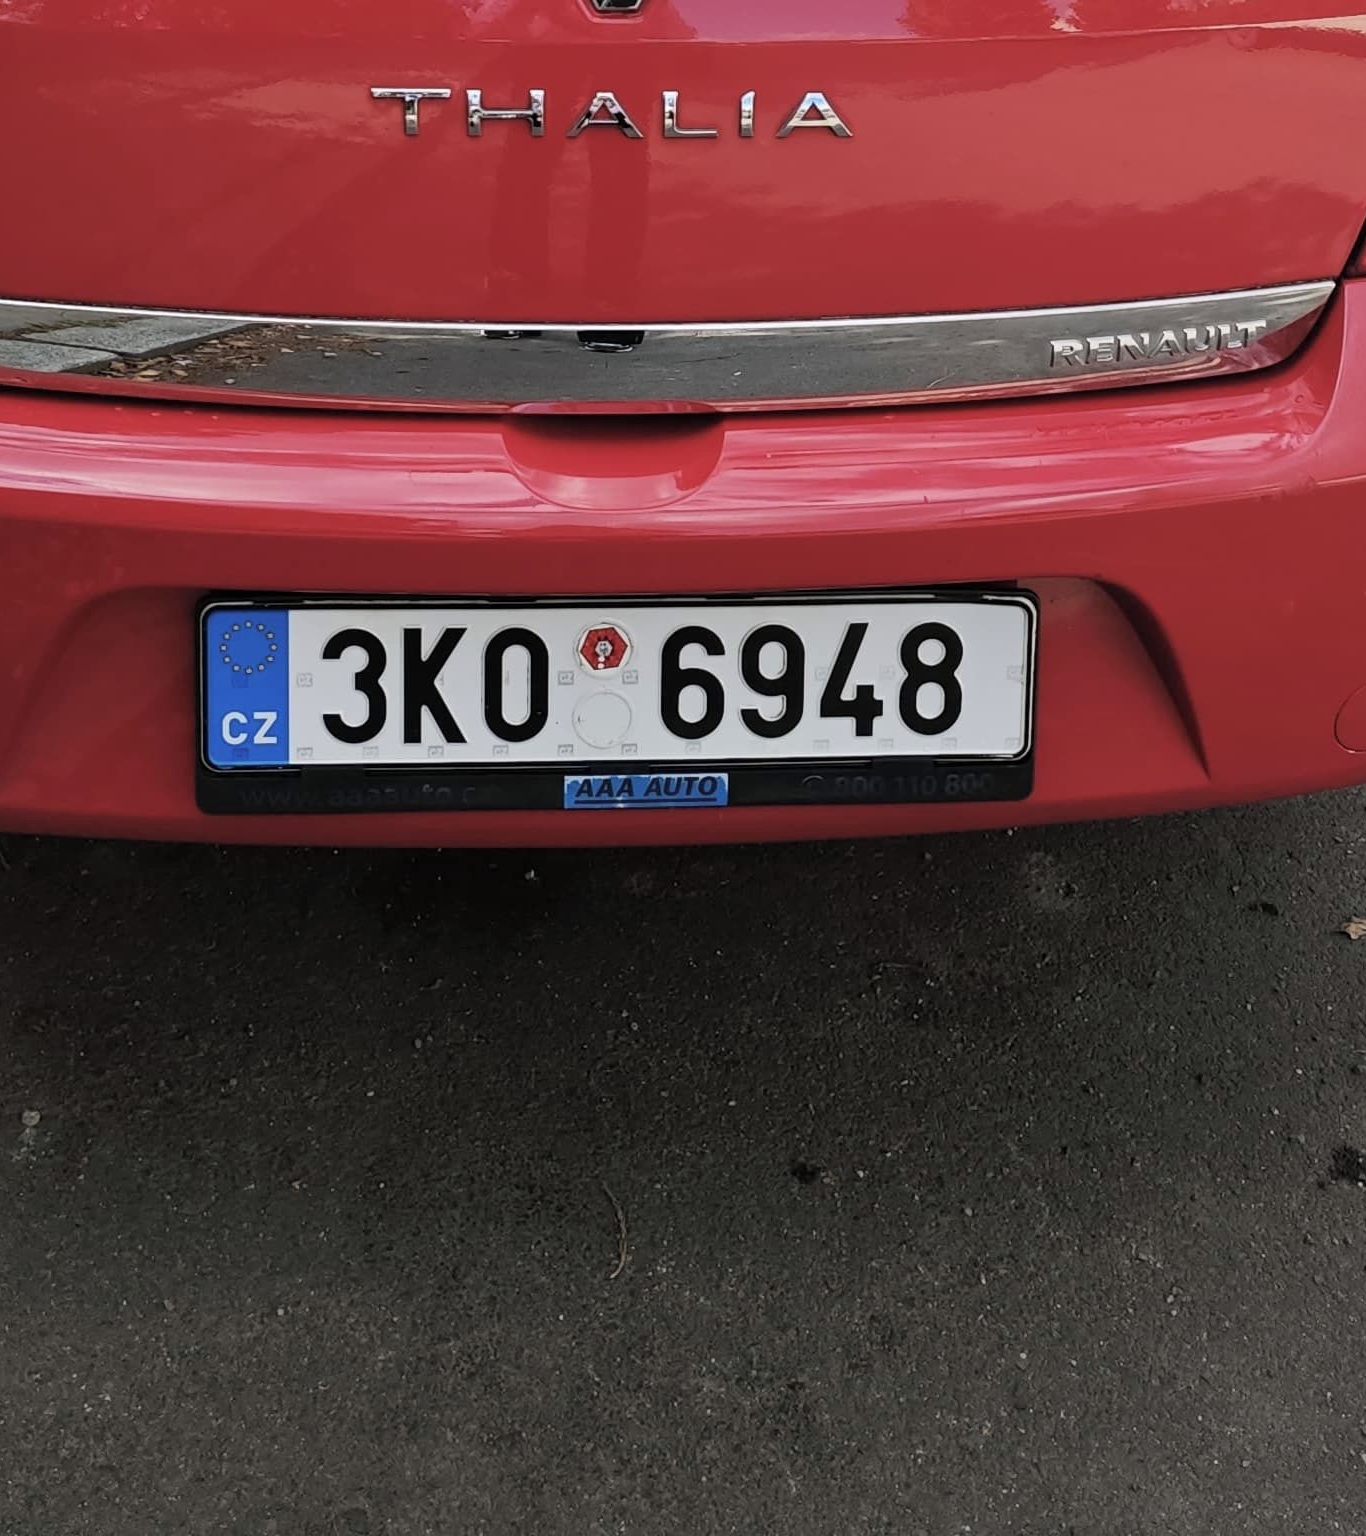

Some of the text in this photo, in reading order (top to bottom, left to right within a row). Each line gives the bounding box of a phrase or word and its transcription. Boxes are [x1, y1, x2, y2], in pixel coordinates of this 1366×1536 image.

[370, 86, 854, 139] THALIA
[1049, 320, 1267, 366] RENAULT
[321, 622, 965, 745] 3K0 6948
[221, 711, 278, 745] CZ
[575, 775, 719, 798] AAA AUTO
